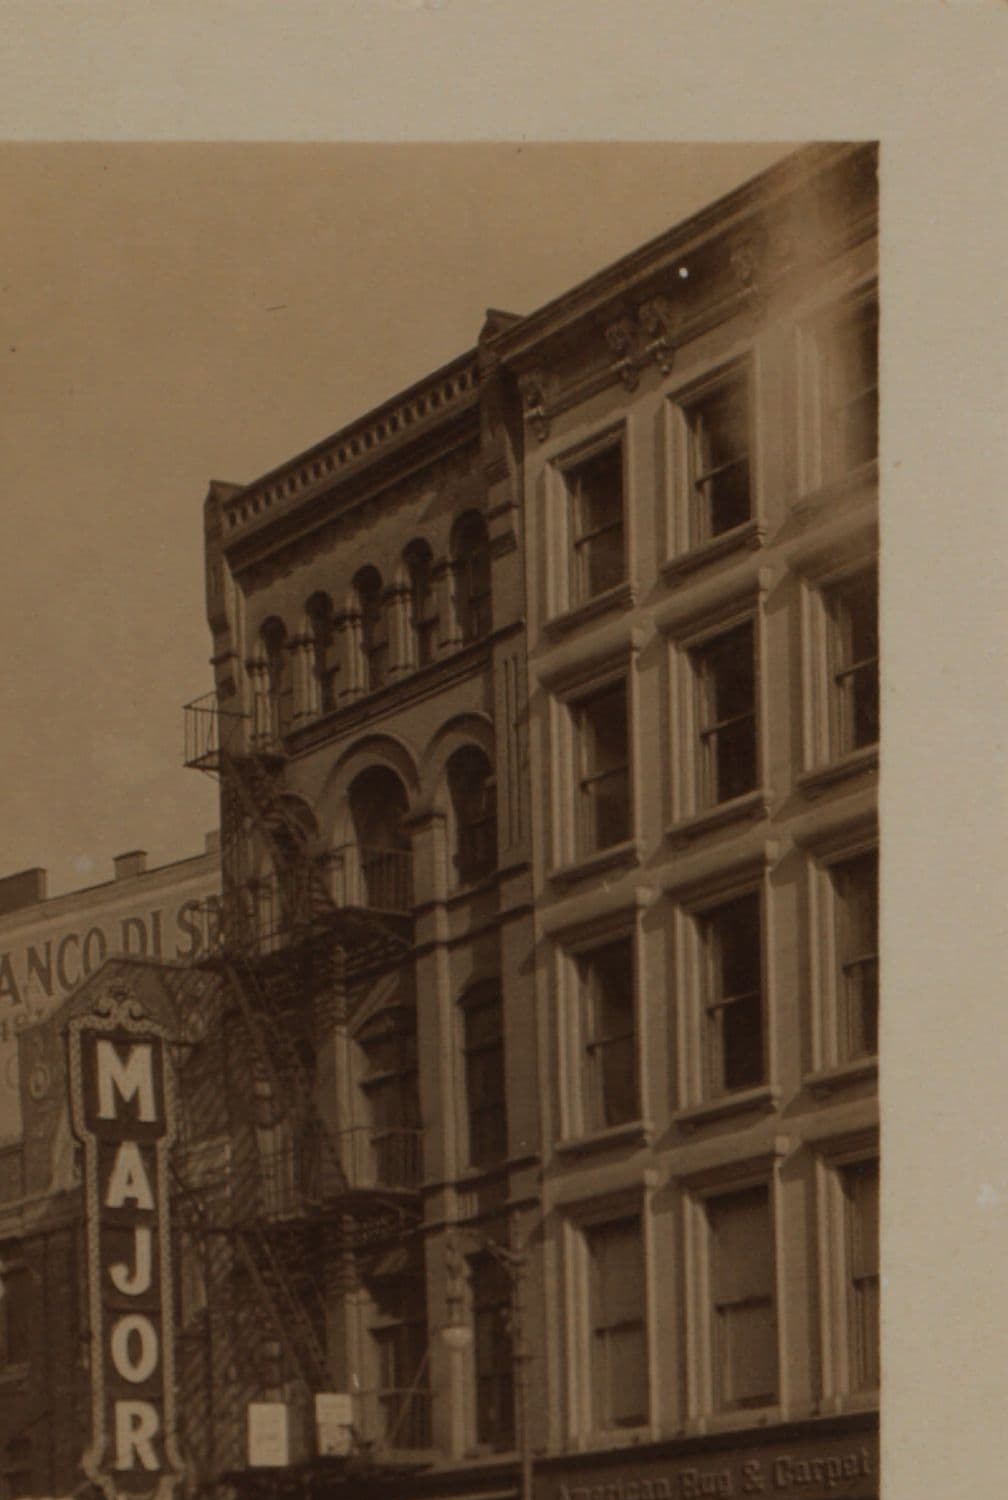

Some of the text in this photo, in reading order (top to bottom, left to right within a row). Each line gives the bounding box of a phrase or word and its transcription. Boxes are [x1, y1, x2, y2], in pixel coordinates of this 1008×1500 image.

[120, 910, 162, 959] DI
[95, 1039, 160, 1472] MAJOR
[678, 1468, 733, 1500] Rug
[742, 1458, 766, 1494] &
[772, 1447, 872, 1492] Carpet
